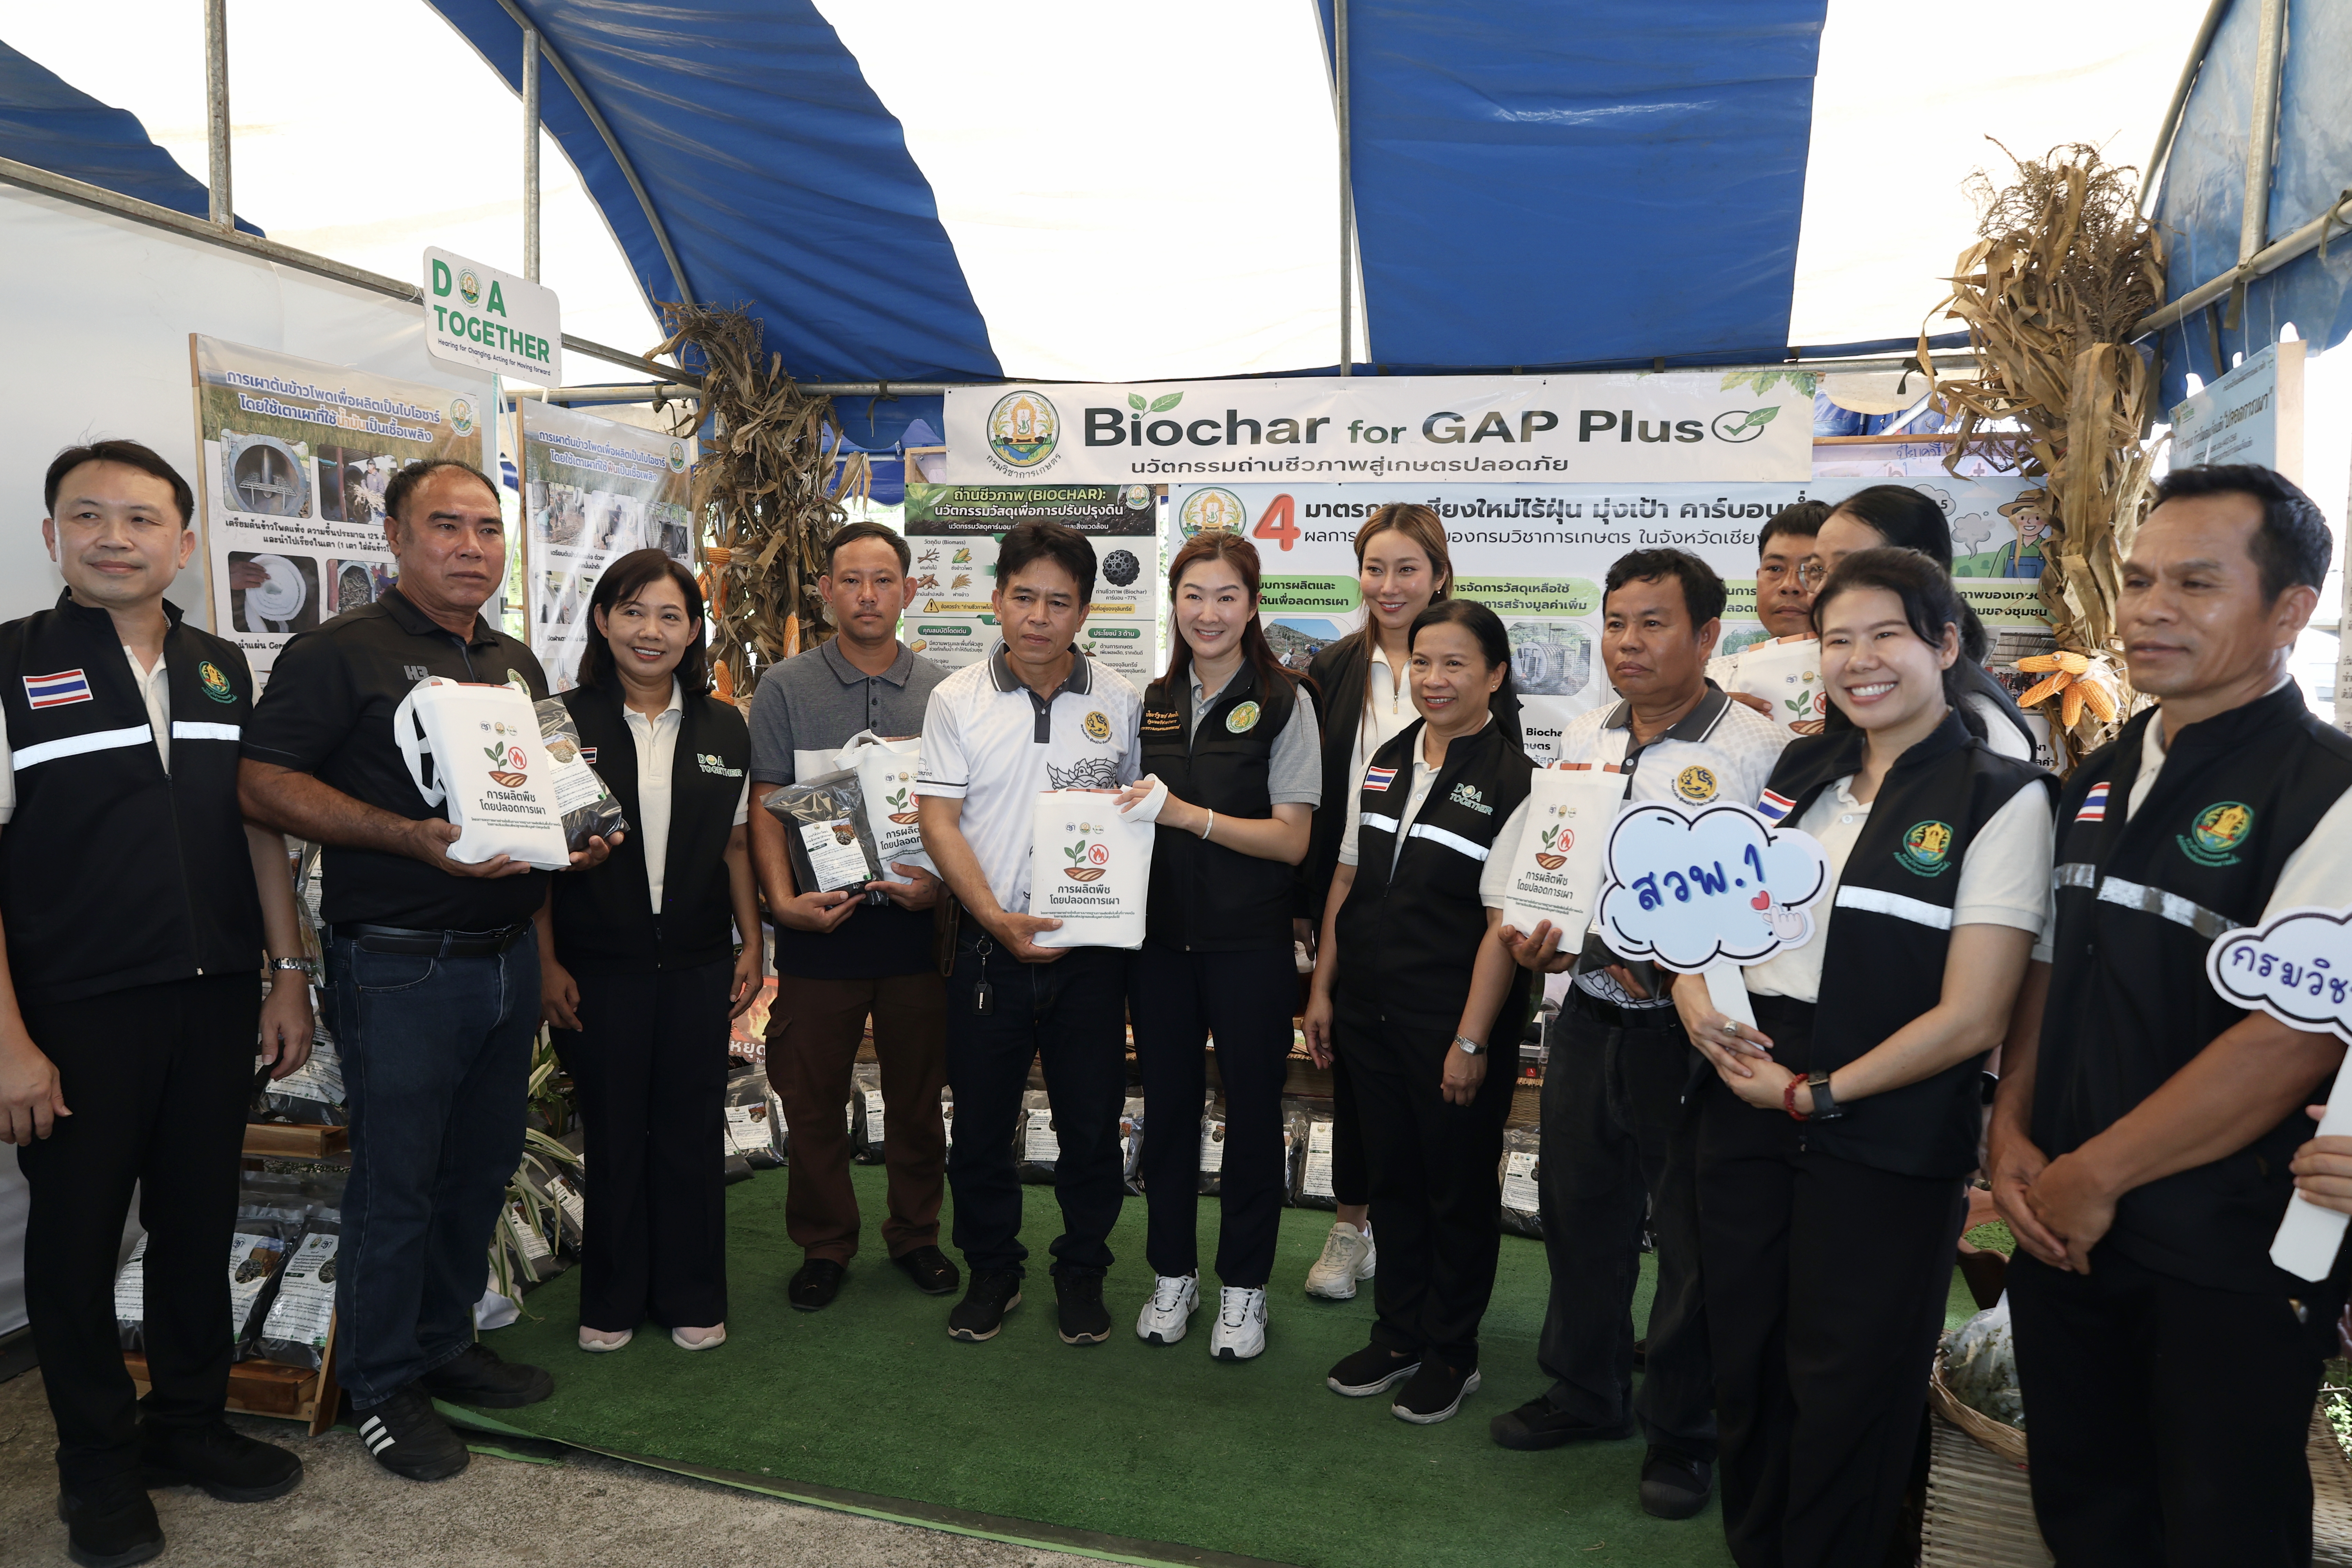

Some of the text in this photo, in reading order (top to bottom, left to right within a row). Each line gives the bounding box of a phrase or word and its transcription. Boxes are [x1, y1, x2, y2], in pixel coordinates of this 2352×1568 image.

[433, 304, 550, 364] TOGETHER
[438, 338, 458, 351] Hearing
[468, 347, 492, 360] Changing,
[493, 354, 508, 365] Acting
[517, 361, 532, 372] Moving
[534, 365, 550, 376] forward
[227, 372, 441, 423] การเผาต้นข้าวโพดเพื่อผลิตเป็นไบโอชาร์
[240, 394, 432, 441] โดยใช้เตาเผาที่ใช้น้ำมันเป็นเชื้อเพลิง
[1085, 408, 1704, 447] Biochar for GAP Plus
[539, 432, 665, 467] การเผาต้นข้าวโพดเพื่อผลิตเป็นไบโอชาร์
[551, 450, 657, 481] โดยใช้เตาเผาที่ใช้ฟืนเป็นเชื้อเพลิง
[986, 454, 1062, 479] กรมวิชาการเกษตร
[1131, 456, 1568, 476] นวัตกรรมถ่านชีวภาพสู่เกษตรปลอดภัย
[954, 487, 1106, 502] ถ่านชีวภาพ (BIOCHAR):
[935, 502, 1123, 519] นวัตกรรมวัสดุเพื่อการปรับปรุงดิน
[1426, 497, 1582, 525] ชียงใหม่ไร้ฝุ่น
[1593, 497, 1669, 525] มุ่งเป้า
[949, 523, 1011, 531] นวัตกรรมวัสดุคาร์บอน
[1252, 493, 1301, 552] 4
[307, 523, 365, 539] ความชื้นประมาณ
[1640, 529, 1759, 544] ในจังหวัดเชีย
[359, 541, 391, 552] ใส่ต้นข้าวโ
[1455, 582, 1570, 595] ารจัดการวัสดุเหลือใช้
[1260, 593, 1349, 606] ดินเพื่อลดการเผา
[1479, 598, 1587, 612] ะการสร้างมูลค่าเพิ่ม
[1090, 604, 1132, 612] ป็นที่อยู่ของจุลินทรีย์
[923, 626, 967, 635] คุณสมบัติโดดเด่น
[269, 641, 285, 650] Cer
[929, 639, 983, 648] มีความพรุนและพื้นที่ผิวสูง
[1526, 728, 1563, 737] Biocha
[699, 764, 743, 777] TOGETHER
[486, 790, 536, 802] การผลิตพืช
[479, 799, 546, 815] โดยปลอดการเผา
[1449, 793, 1494, 816] TOGETHER
[886, 826, 920, 839] การผลิต
[880, 836, 922, 850] โดยปลอดก
[1526, 871, 1568, 886] การผลิตพืช
[1632, 843, 1765, 911] สวพ.1
[1058, 884, 1110, 894] การผลิตพืช
[1517, 878, 1573, 900] โดยปลอดการเผา
[1050, 894, 1120, 905] โดยปลอดการเผา
[2232, 946, 2352, 1004] กรมวิช
